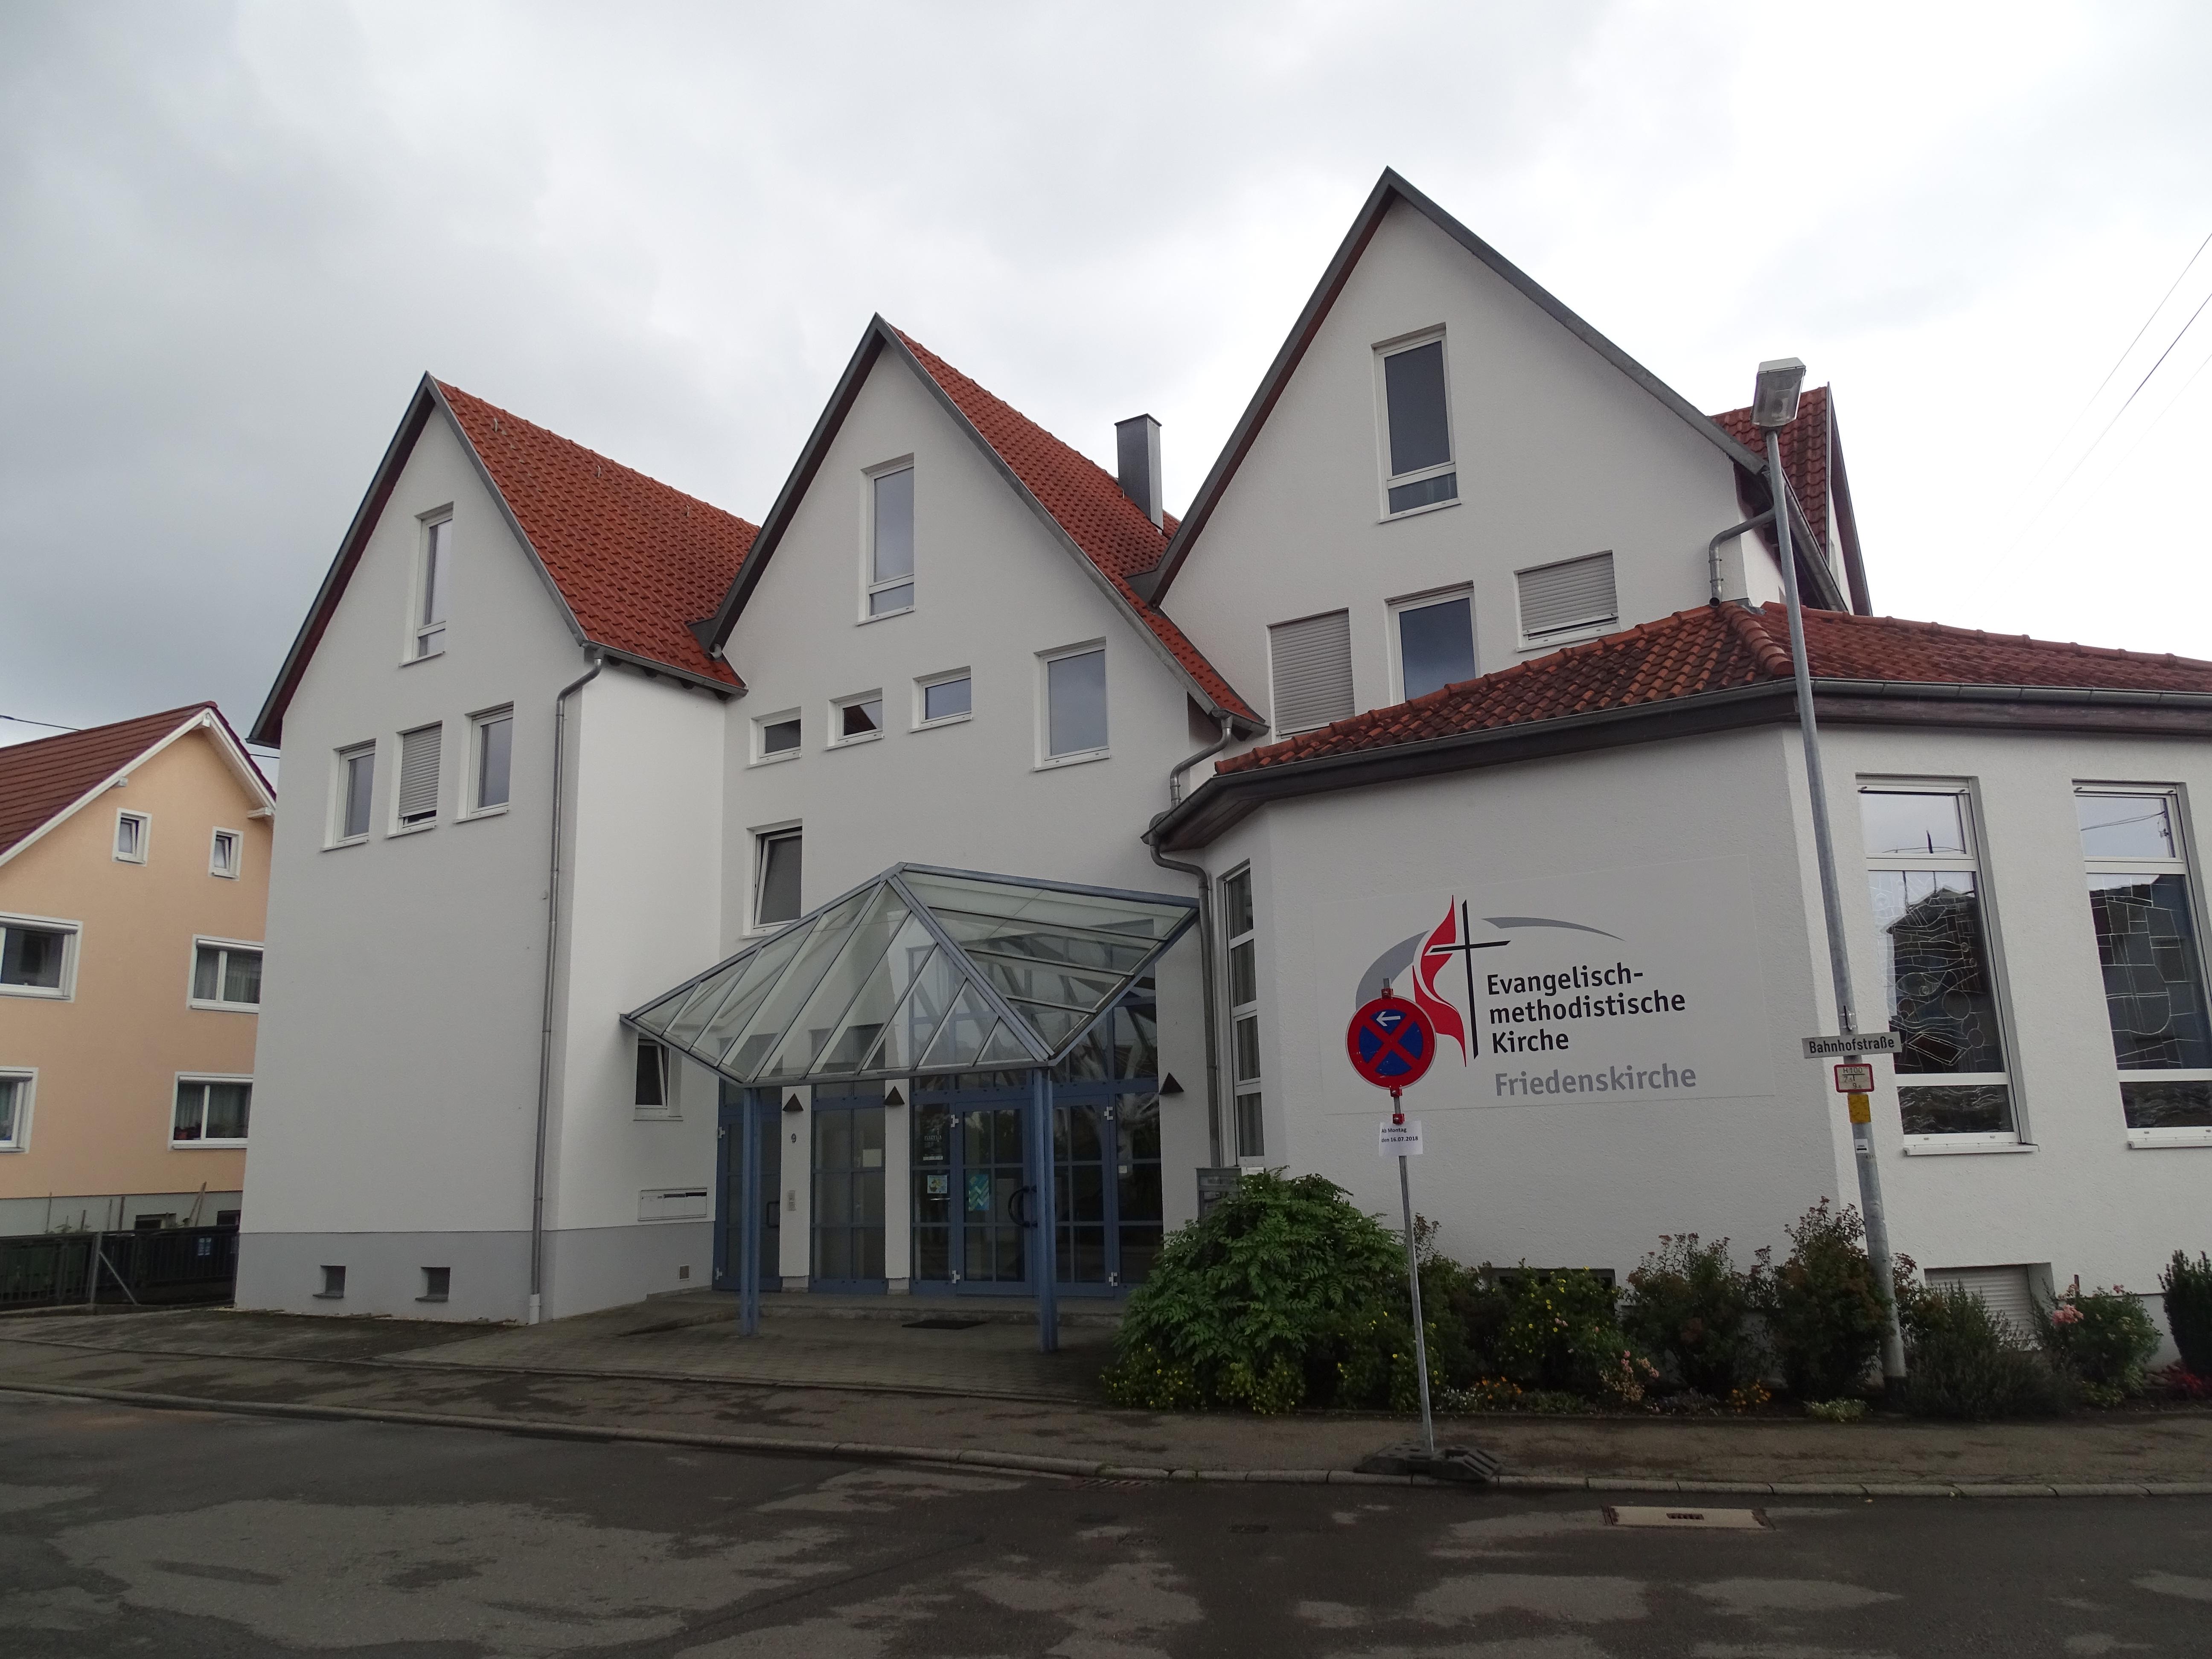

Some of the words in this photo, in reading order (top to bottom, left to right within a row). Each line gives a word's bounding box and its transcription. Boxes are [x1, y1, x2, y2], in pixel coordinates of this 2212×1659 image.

[1488, 962, 1644, 996] Evangelisch-
[1490, 990, 1685, 1024] methodistische
[1493, 1029, 1569, 1054] Kirche
[1809, 1036, 1895, 1054] Bahnhofstraße
[1496, 1063, 1696, 1097] Friedenskirche
